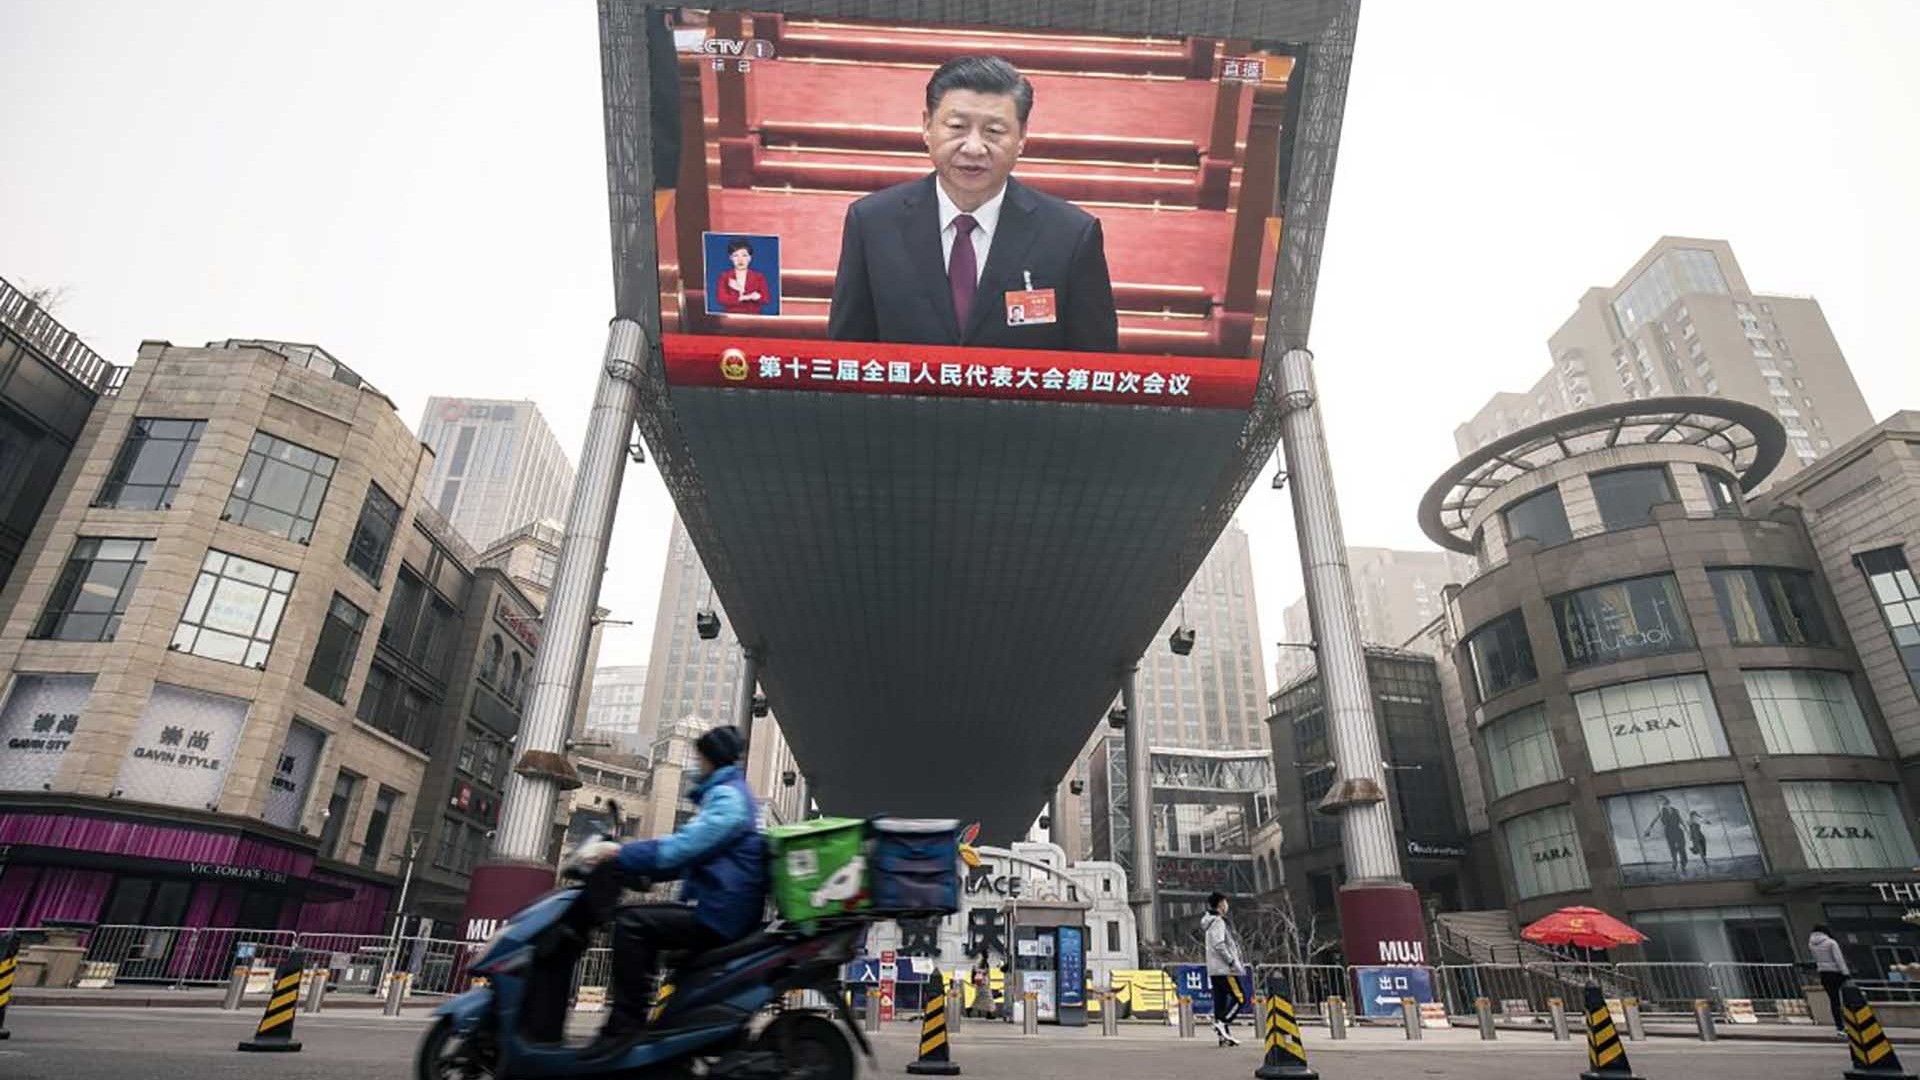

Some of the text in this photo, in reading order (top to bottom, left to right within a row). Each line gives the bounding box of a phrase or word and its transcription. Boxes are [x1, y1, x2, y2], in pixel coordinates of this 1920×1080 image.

[758, 355, 1192, 396] 第十三届全国人民代表大会第四次会议
[1613, 718, 1681, 737] ZARA
[133, 747, 221, 771] GAVIN STYLE
[1813, 826, 1876, 839] ZARA
[1534, 846, 1573, 862] ZARA
[1378, 940, 1424, 962] MUJI
[1378, 975, 1408, 991] 出口
